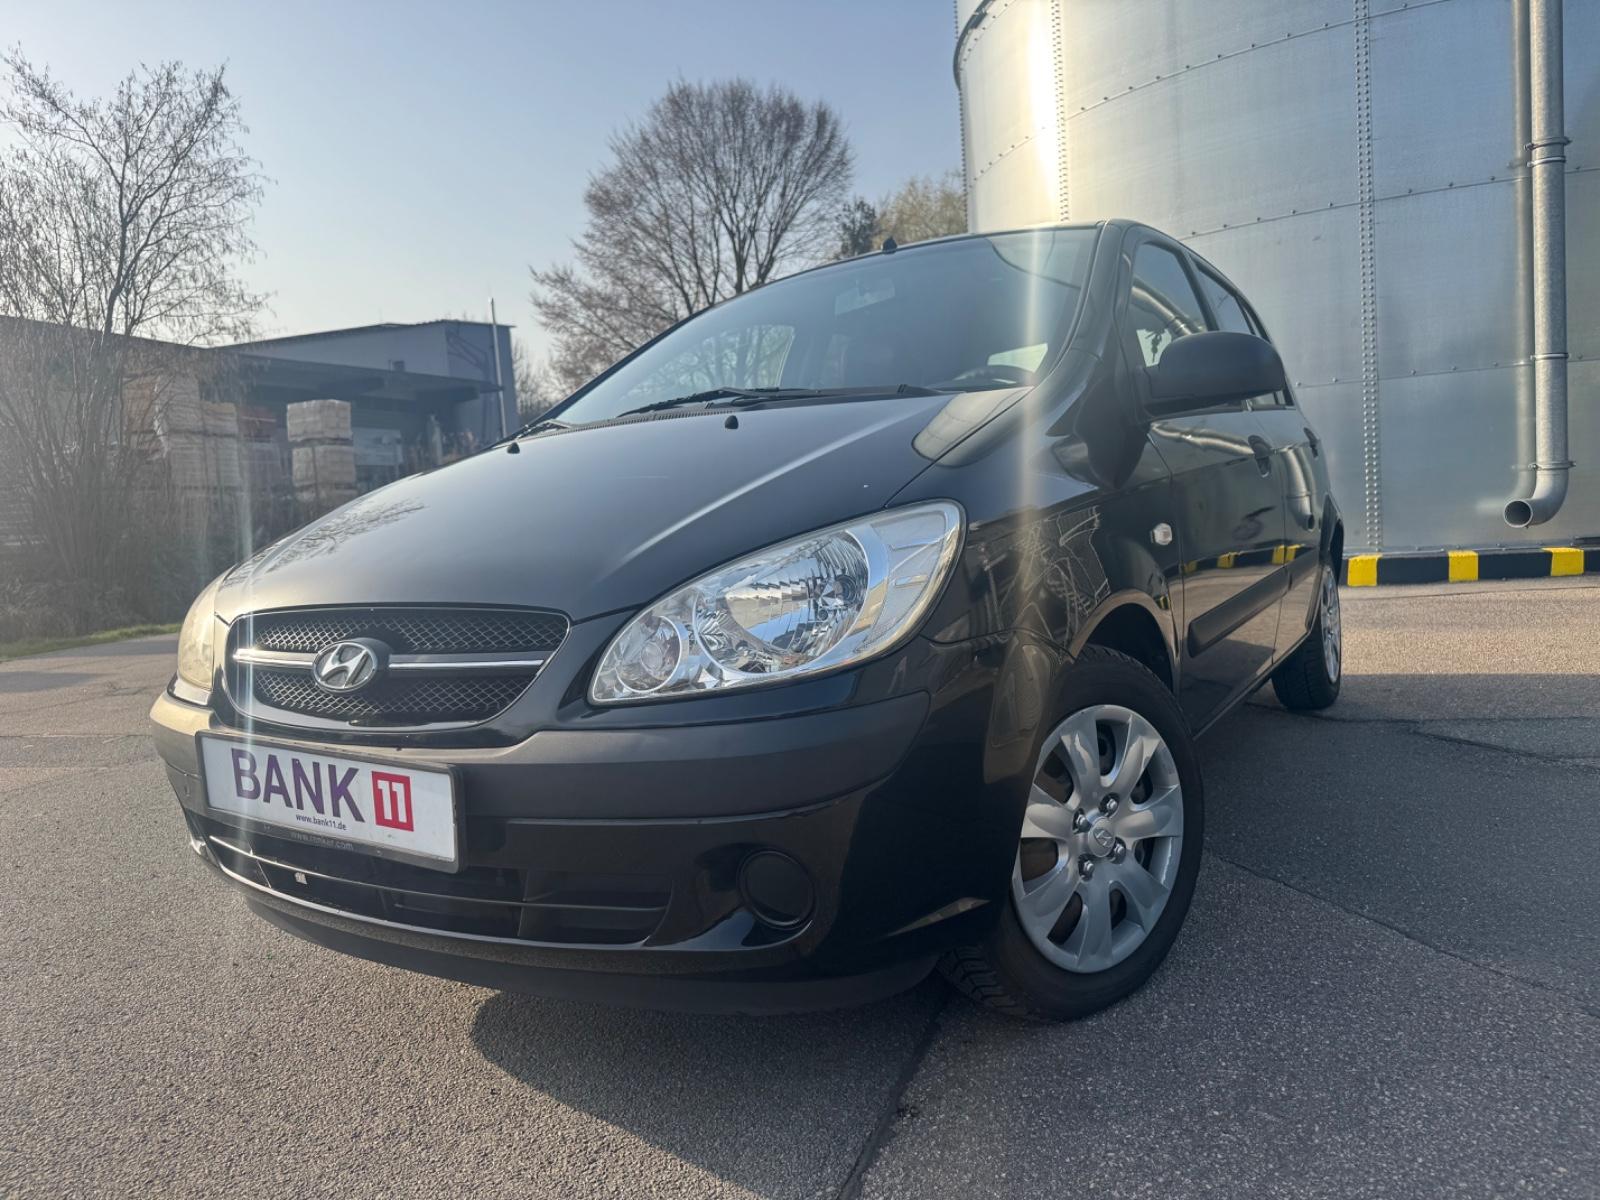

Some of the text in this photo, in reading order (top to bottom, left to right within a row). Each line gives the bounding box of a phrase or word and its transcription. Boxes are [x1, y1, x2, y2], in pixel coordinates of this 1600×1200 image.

[231, 747, 408, 823] BANK 11
[295, 813, 347, 831] www.bank11.de
